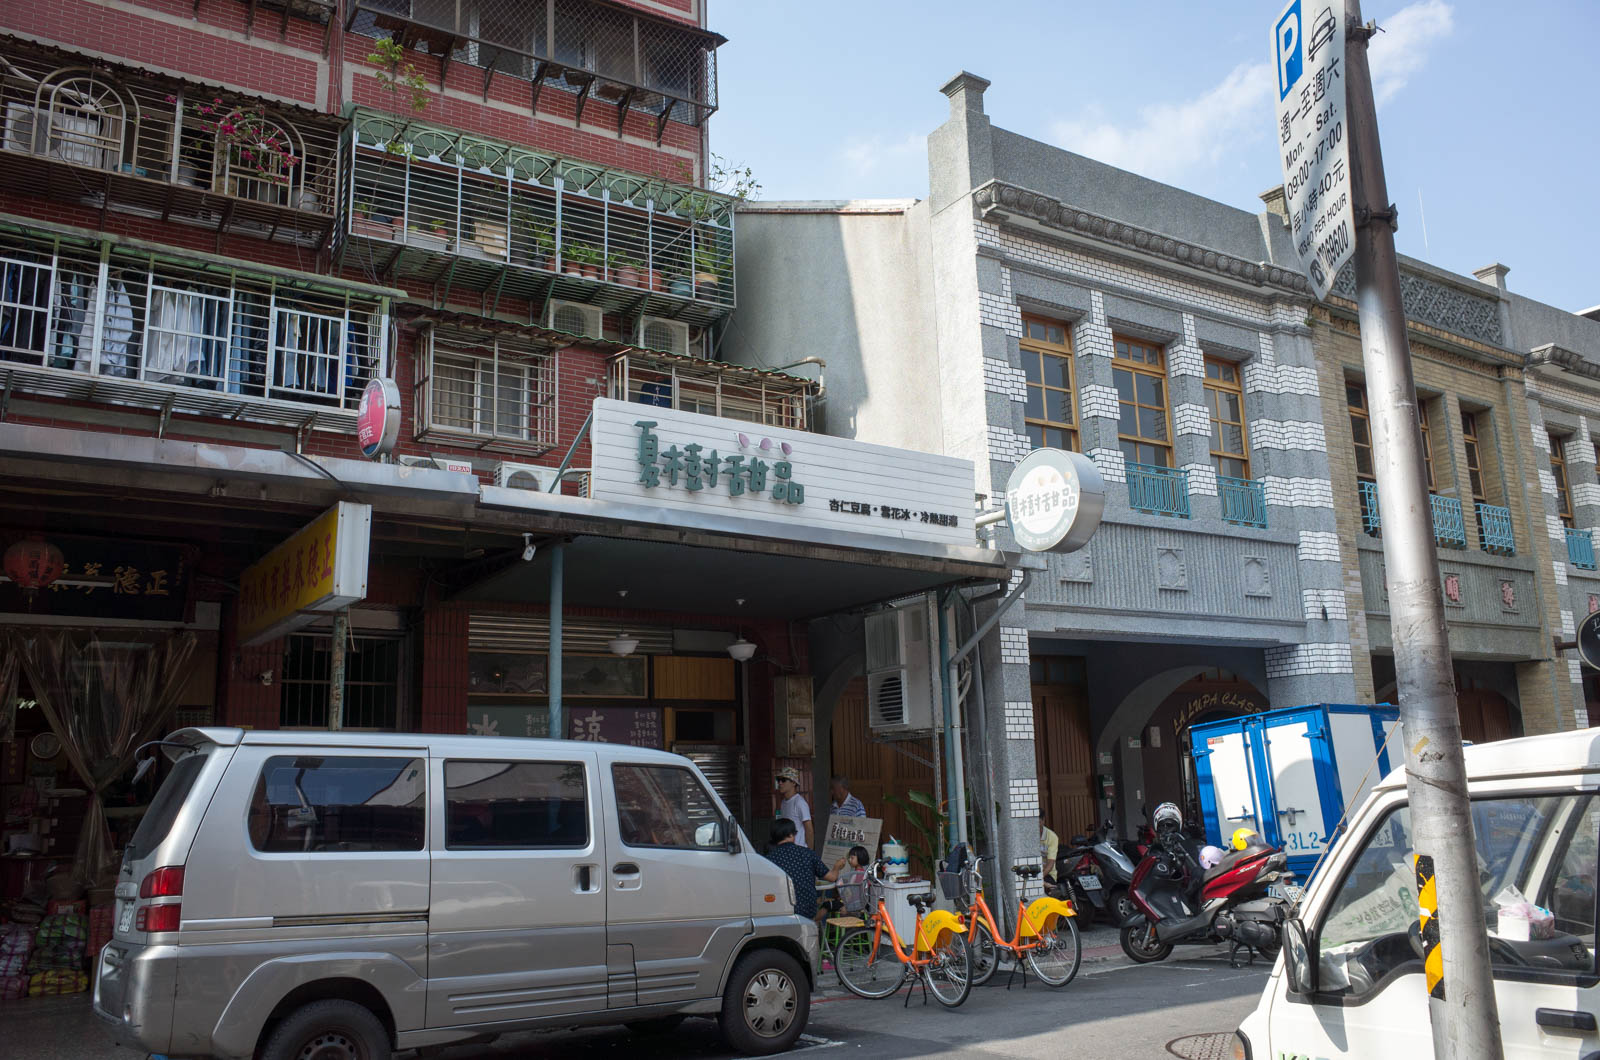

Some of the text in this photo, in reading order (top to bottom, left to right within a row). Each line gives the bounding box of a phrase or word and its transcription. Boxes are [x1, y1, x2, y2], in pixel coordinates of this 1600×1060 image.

[1280, 57, 1340, 147] 週一至週六
[1285, 141, 1305, 171] Mon.
[1316, 101, 1338, 132] Sat.
[1287, 121, 1342, 201] 09:00-17:00
[1314, 214, 1326, 238] PER
[1327, 192, 1347, 222] HOUR
[634, 421, 805, 505] 夏樹甜品
[1009, 487, 1076, 522] 夏樹甜品
[573, 709, 608, 743] 涼
